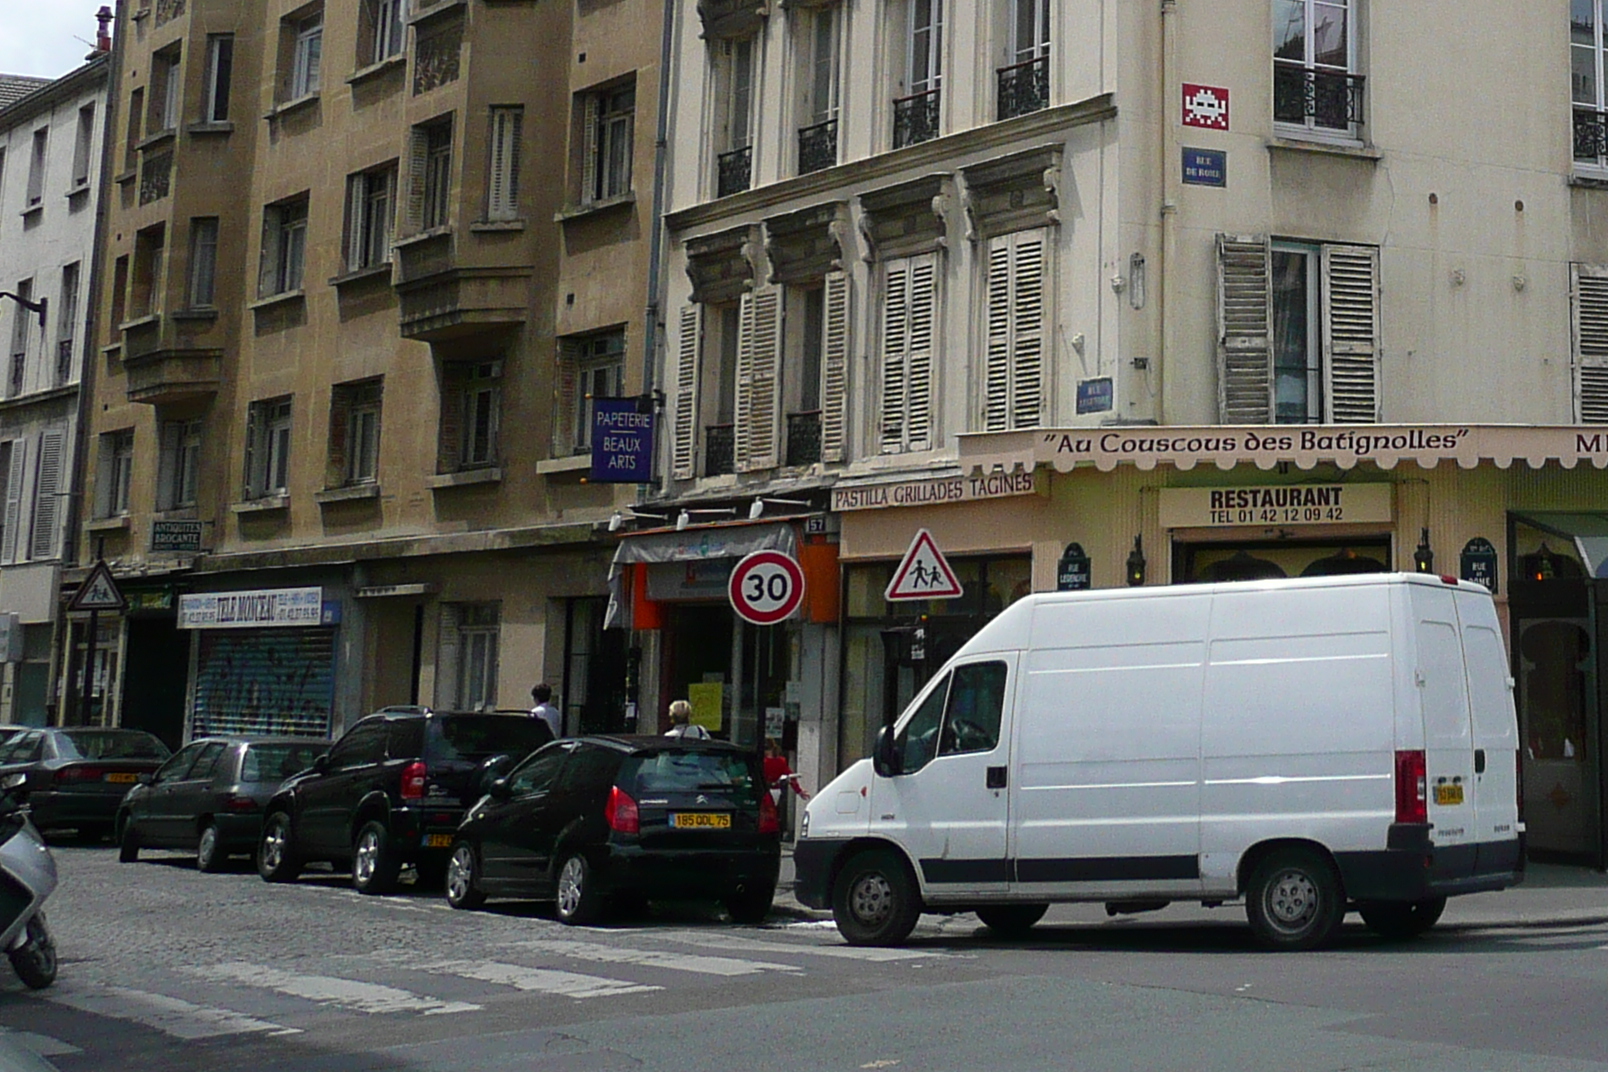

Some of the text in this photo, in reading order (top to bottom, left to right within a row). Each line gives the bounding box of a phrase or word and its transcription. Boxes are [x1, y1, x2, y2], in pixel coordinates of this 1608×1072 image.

[1196, 156, 1212, 166] RUE
[1186, 167, 1198, 176] DE
[597, 411, 650, 428] PAPETERIE
[603, 437, 641, 452] BEAUX
[1100, 433, 1236, 453] Couscous
[1244, 432, 1292, 451] des
[1300, 429, 1469, 455] Batignolles"
[608, 455, 636, 469] ARTS
[835, 473, 1032, 508] PASTILLA GRILLADES TAGINES
[1211, 487, 1343, 509] RESTAURANT
[1210, 507, 1343, 524] TEL 01 42 12 09 42
[154, 534, 199, 544] BROCANTE
[1472, 562, 1487, 571] RUE
[746, 574, 787, 602] 30
[716, 815, 729, 826] 75
